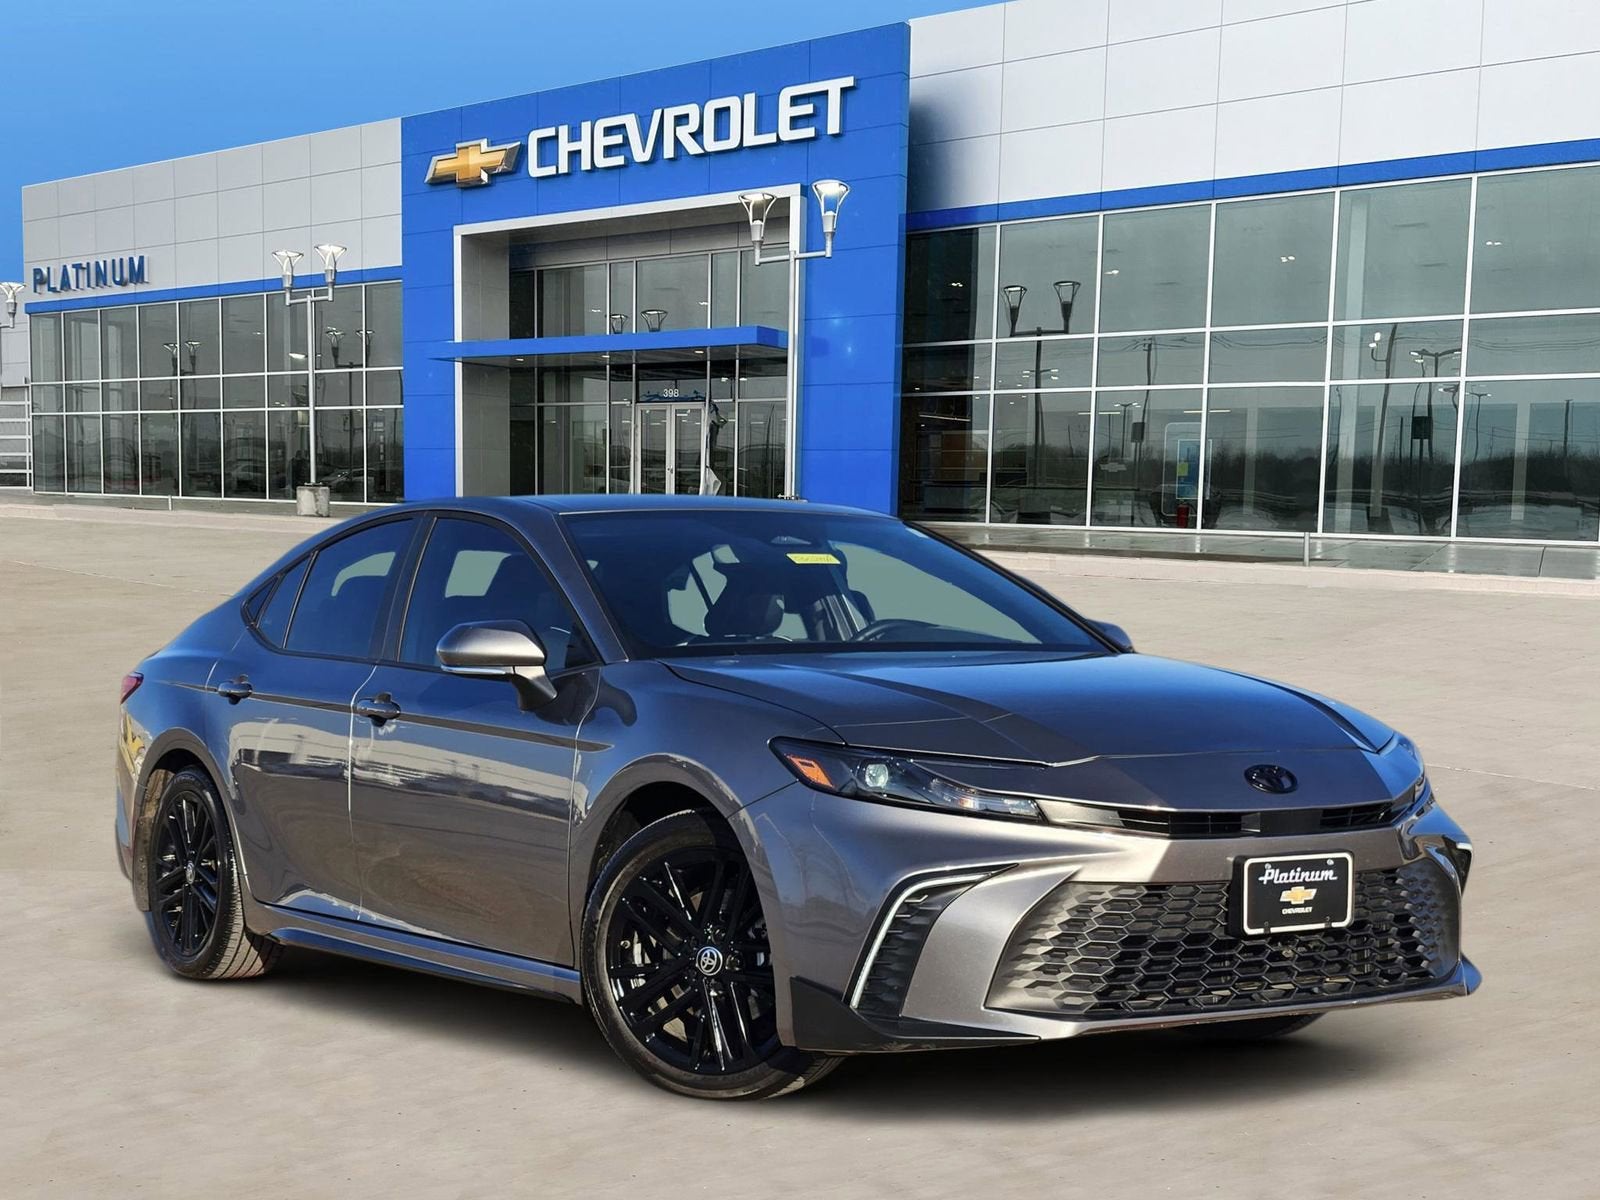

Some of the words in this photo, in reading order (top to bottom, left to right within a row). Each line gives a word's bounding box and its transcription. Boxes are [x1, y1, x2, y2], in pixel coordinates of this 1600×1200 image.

[527, 76, 855, 178] CHEVROLET
[33, 255, 146, 293] PLATINUM
[663, 388, 679, 398] 398
[1258, 867, 1338, 885] Platinum
